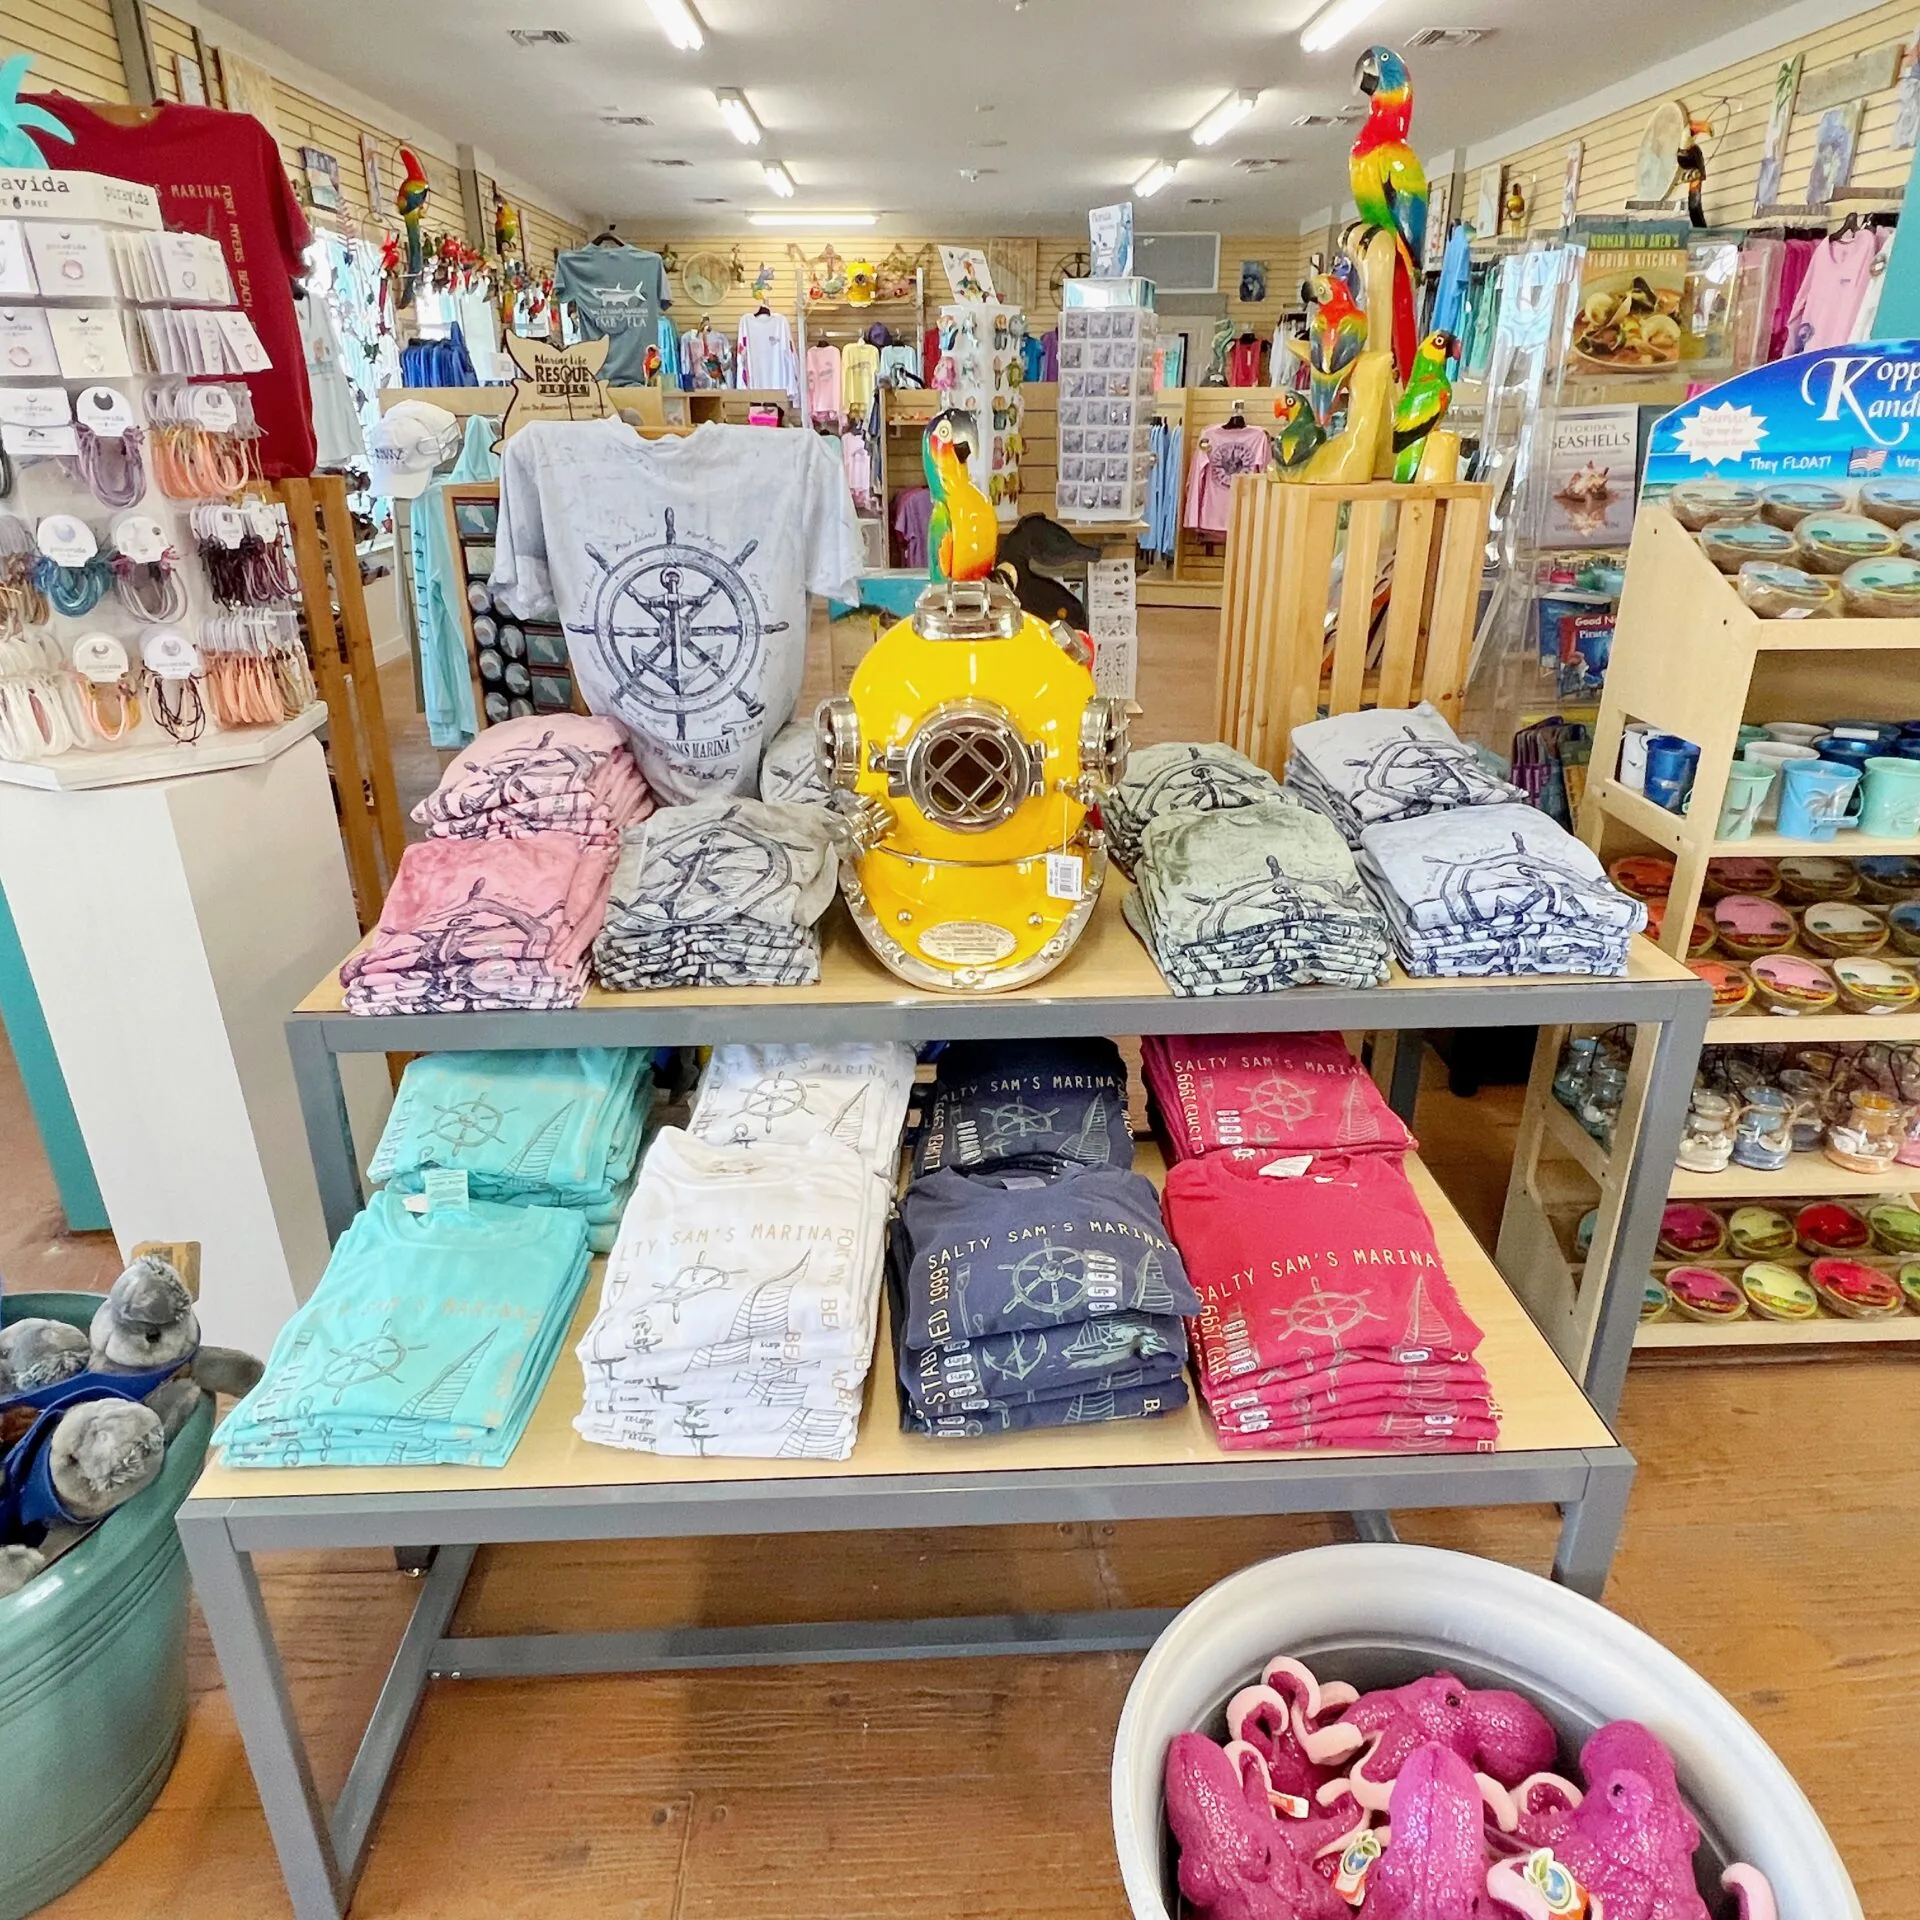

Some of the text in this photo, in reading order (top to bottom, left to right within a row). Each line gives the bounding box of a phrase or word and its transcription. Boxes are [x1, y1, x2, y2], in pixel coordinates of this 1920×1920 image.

[171, 184, 222, 199] MARINA
[1588, 252, 1678, 268] FLORIDA KITCHEN
[1749, 455, 1832, 475] They FLOAT!
[1575, 616, 1601, 627] Good
[692, 738, 731, 759] MARINA
[821, 1063, 887, 1079] MARINA
[1173, 1057, 1228, 1073] SALTY
[1241, 1056, 1294, 1070] SAM'S
[990, 1076, 1041, 1092] SAM'S
[1053, 1075, 1116, 1089] MARINA
[669, 1226, 736, 1247] SAM'S
[751, 1222, 834, 1242] MARINA
[928, 1221, 1168, 1270] SALTY SAM'S MARINA
[1194, 1248, 1438, 1303] SALTY SAM'S MARINA
[929, 1266, 950, 1306] 1999
[1231, 1362, 1255, 1374] Small
